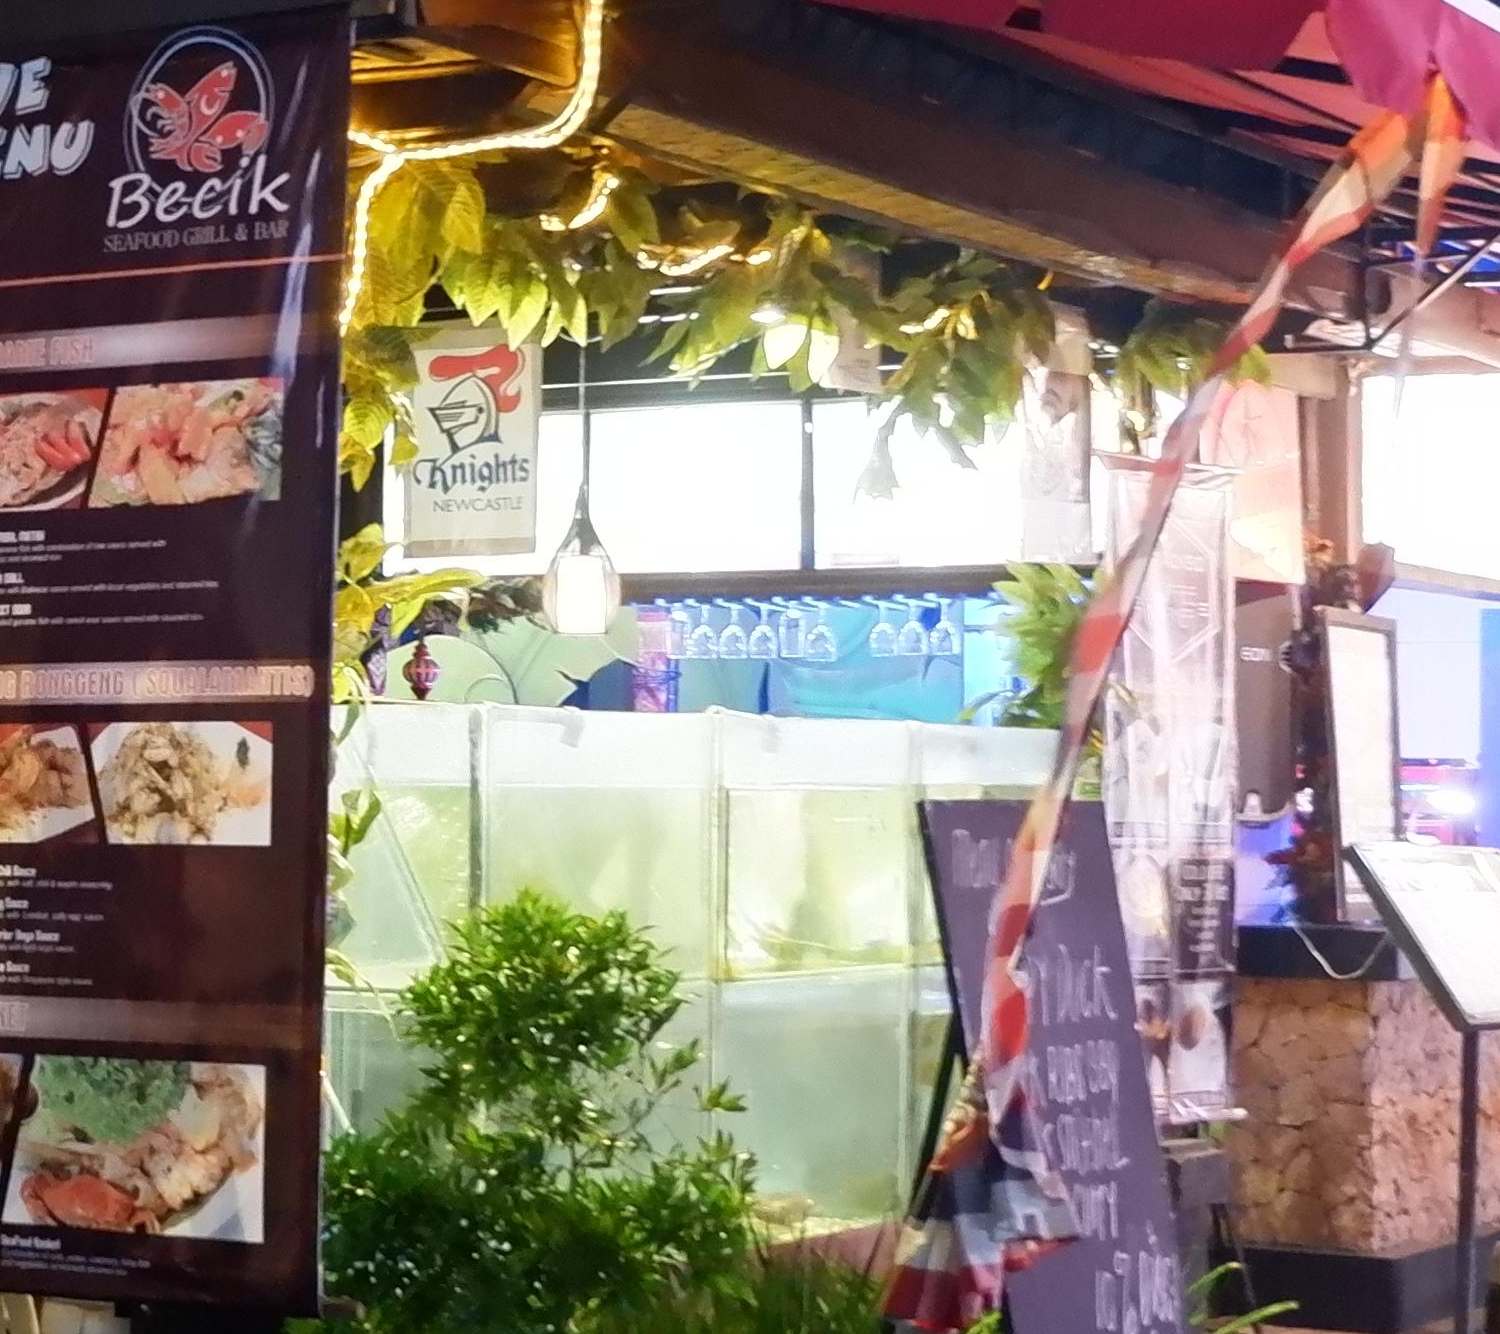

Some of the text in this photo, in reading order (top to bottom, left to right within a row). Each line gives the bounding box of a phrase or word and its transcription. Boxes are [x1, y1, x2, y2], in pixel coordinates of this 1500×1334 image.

[106, 158, 291, 229] Becik
[103, 218, 291, 255] SEAFOOD GRILL & BAR
[412, 452, 530, 495] Knights
[433, 496, 524, 513] NEWCASTLE
